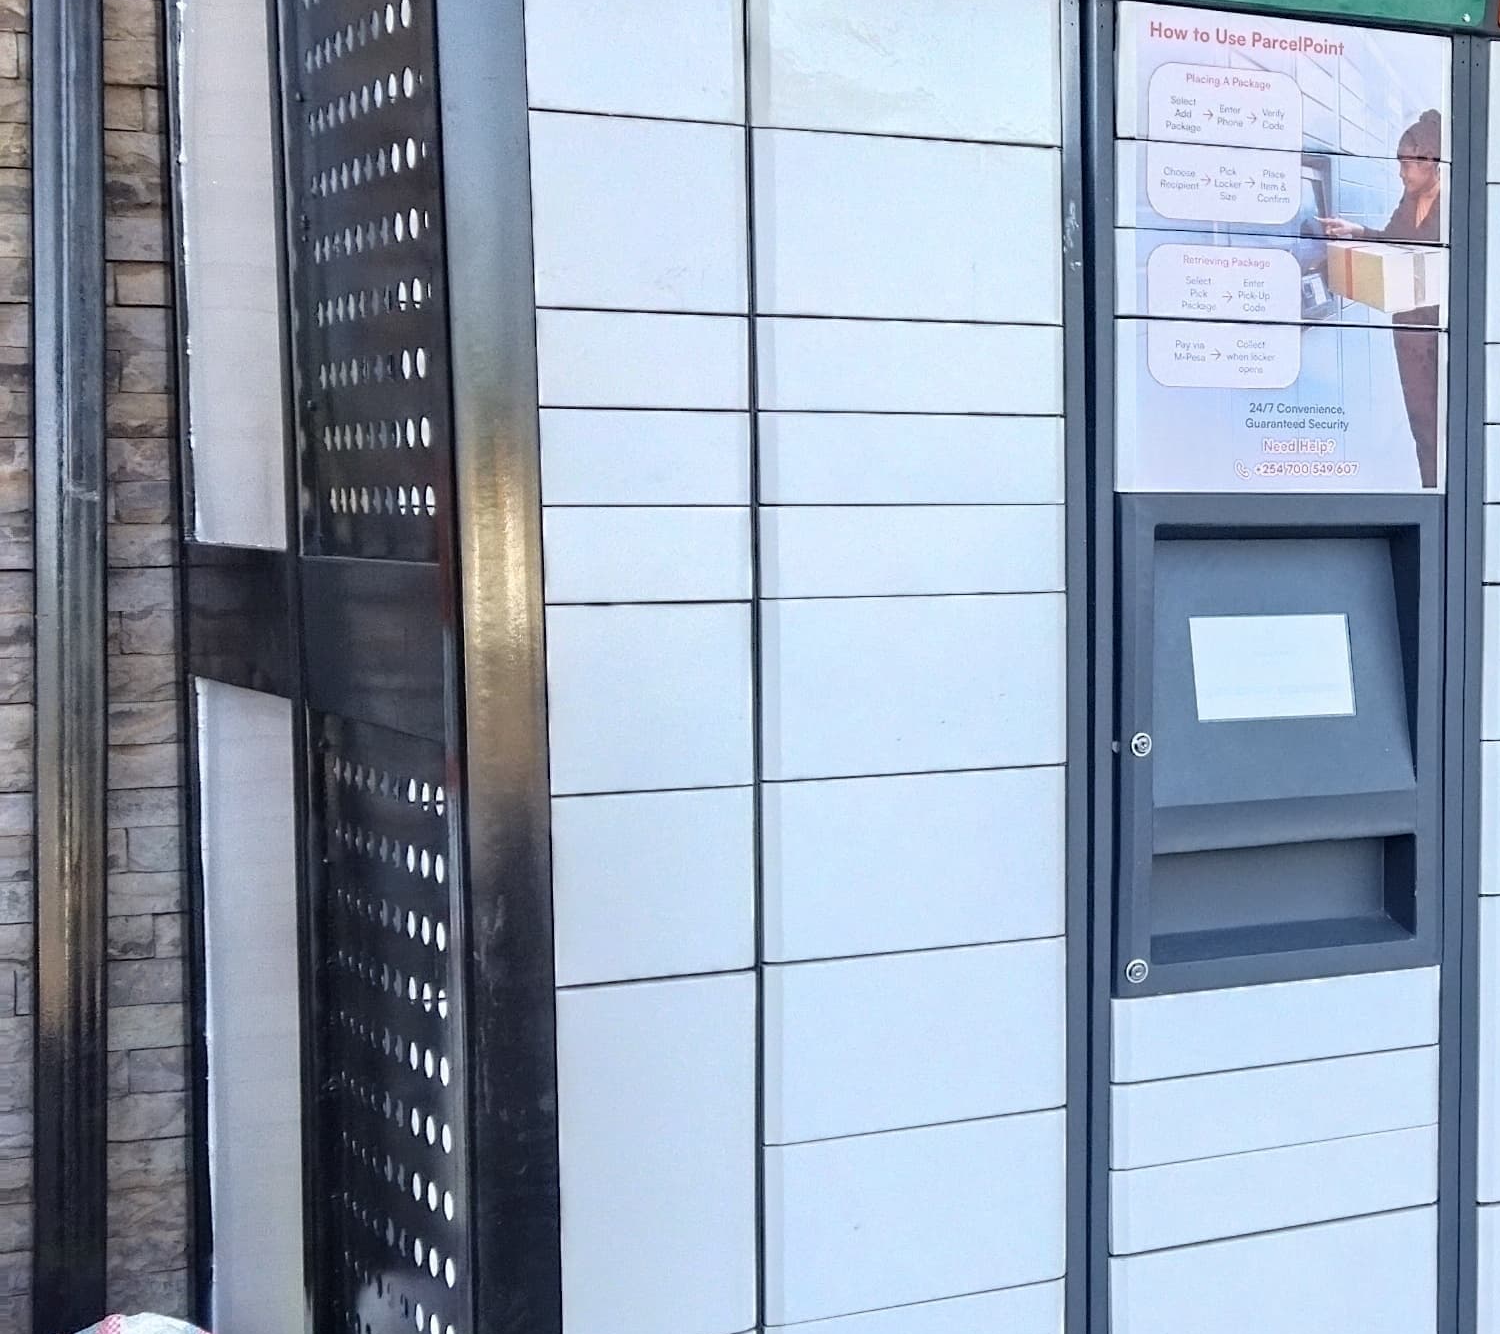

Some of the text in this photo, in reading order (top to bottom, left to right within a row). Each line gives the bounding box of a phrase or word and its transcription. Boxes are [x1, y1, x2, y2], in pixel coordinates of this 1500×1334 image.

[1150, 21, 1345, 56] How to Use ParcelPoint
[1186, 73, 1271, 91] Placing A Package
[1170, 95, 1196, 106] Select
[1174, 109, 1192, 119] Add
[1219, 104, 1241, 115] Enter
[1262, 108, 1285, 120] Verify
[1165, 121, 1201, 133] Package
[1217, 117, 1243, 128] Phone
[1262, 121, 1285, 131] Code
[1163, 166, 1196, 178] Choose
[1219, 166, 1236, 176] Pick
[1262, 169, 1286, 179] Place
[1160, 179, 1199, 191] Recipient
[1214, 179, 1242, 189] Locker
[1260, 181, 1287, 192] Item &
[1219, 192, 1237, 202] Size
[1257, 193, 1290, 204] Confirm
[1183, 254, 1271, 270] Retrieving Package
[1185, 275, 1212, 286] Select
[1243, 278, 1265, 288] Enter
[1190, 288, 1208, 298] Pick
[1238, 290, 1271, 301] Pick-Up
[1181, 300, 1216, 312] Package
[1242, 303, 1266, 313] Code
[1175, 339, 1206, 351] Pay via
[1236, 339, 1265, 349] Collect
[1174, 352, 1206, 362] M-Pesa
[1226, 352, 1276, 362] when locker
[1238, 366, 1264, 376] opens
[1249, 402, 1346, 416] 24/7 Convenience,
[1245, 417, 1349, 432] Guaranteed Security
[1264, 439, 1335, 455] Need Help?
[1256, 463, 1358, 475] +254 700 549 607
